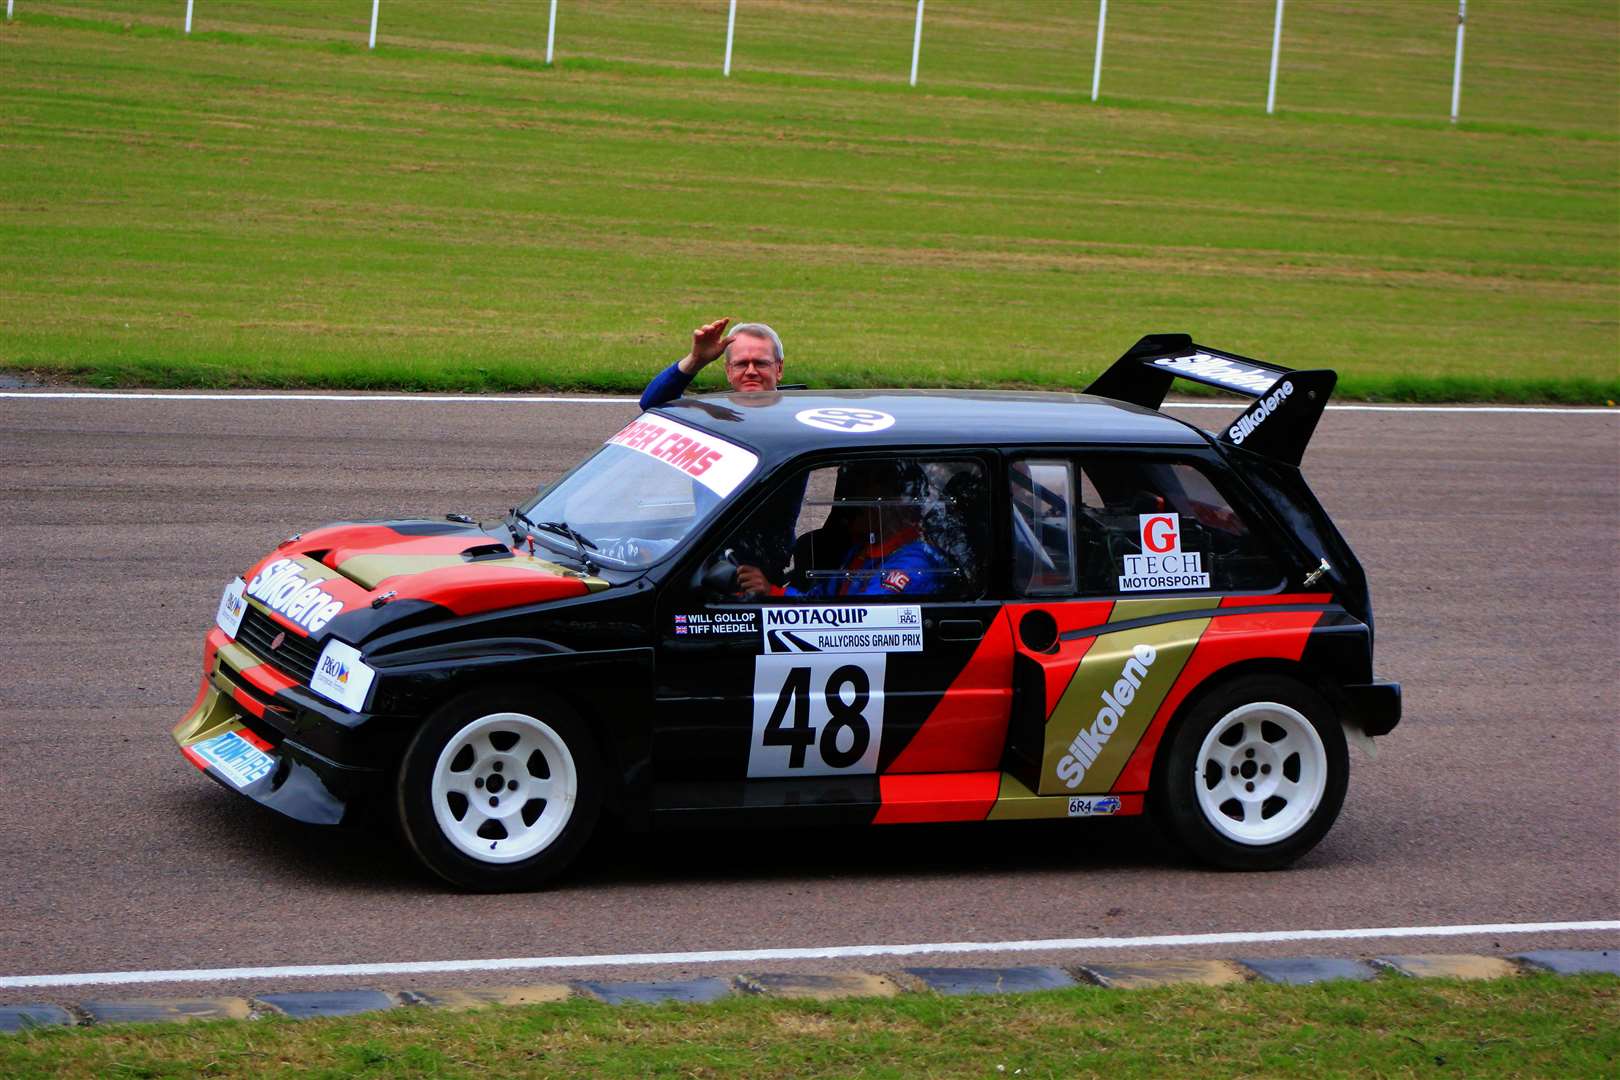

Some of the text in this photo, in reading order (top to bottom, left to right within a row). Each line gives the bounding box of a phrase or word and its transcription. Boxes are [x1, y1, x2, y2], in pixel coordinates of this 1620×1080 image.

[808, 409, 885, 429] 48
[1229, 381, 1294, 445] Silkolene
[650, 433, 723, 476] CAMS
[1143, 516, 1177, 553] G
[1127, 555, 1198, 574] TECH
[1123, 575, 1206, 588] MOTORSPORT
[247, 559, 344, 632] Silkolene
[688, 613, 756, 623] WILL GOLLOP
[767, 608, 868, 627] MOTAQUIP
[900, 614, 917, 624] RAC
[688, 623, 759, 634] TIFF NEEDELL
[818, 633, 921, 648] RALLYCROSS GRAND PRIX
[321, 655, 341, 677] P&O
[763, 664, 871, 769] 48
[1056, 644, 1156, 789] Silkolene
[1070, 800, 1091, 812] 6R4
